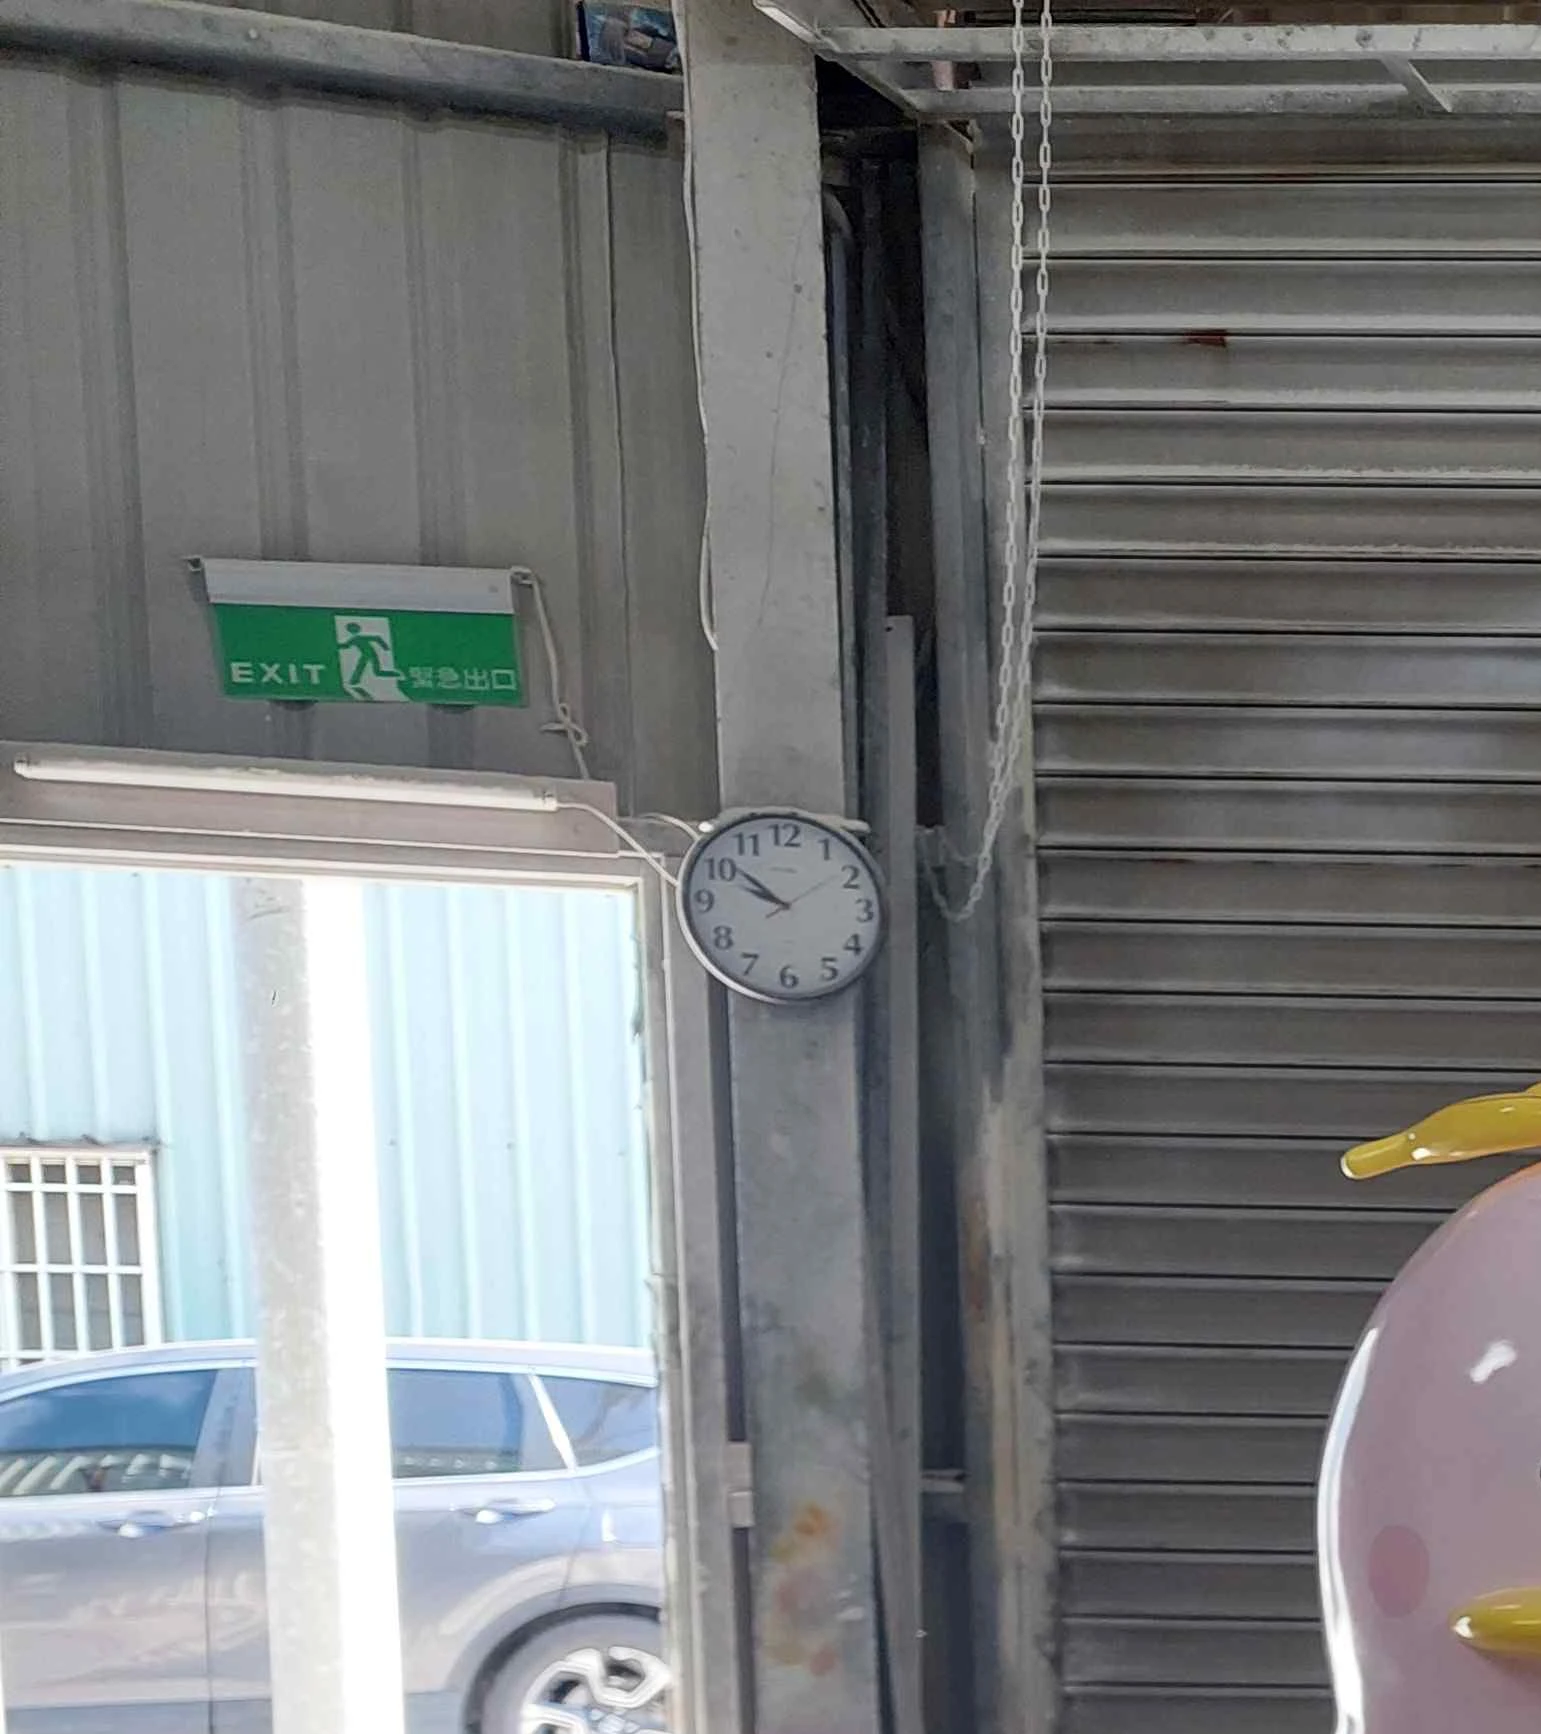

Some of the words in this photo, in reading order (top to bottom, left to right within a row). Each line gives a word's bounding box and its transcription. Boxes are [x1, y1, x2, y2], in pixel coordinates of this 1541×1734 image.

[230, 661, 326, 686] EXIT
[408, 666, 517, 692] 緊急出口
[733, 831, 760, 857] 11
[767, 823, 801, 848] 12
[819, 838, 832, 861] 1
[705, 857, 737, 882] 10
[841, 864, 860, 890] 2
[694, 888, 715, 914] 9
[856, 898, 875, 923] 3
[713, 925, 734, 950] 8
[842, 933, 863, 956] 4
[740, 952, 760, 976] 7
[779, 964, 799, 989] 6
[820, 957, 839, 982] 5
